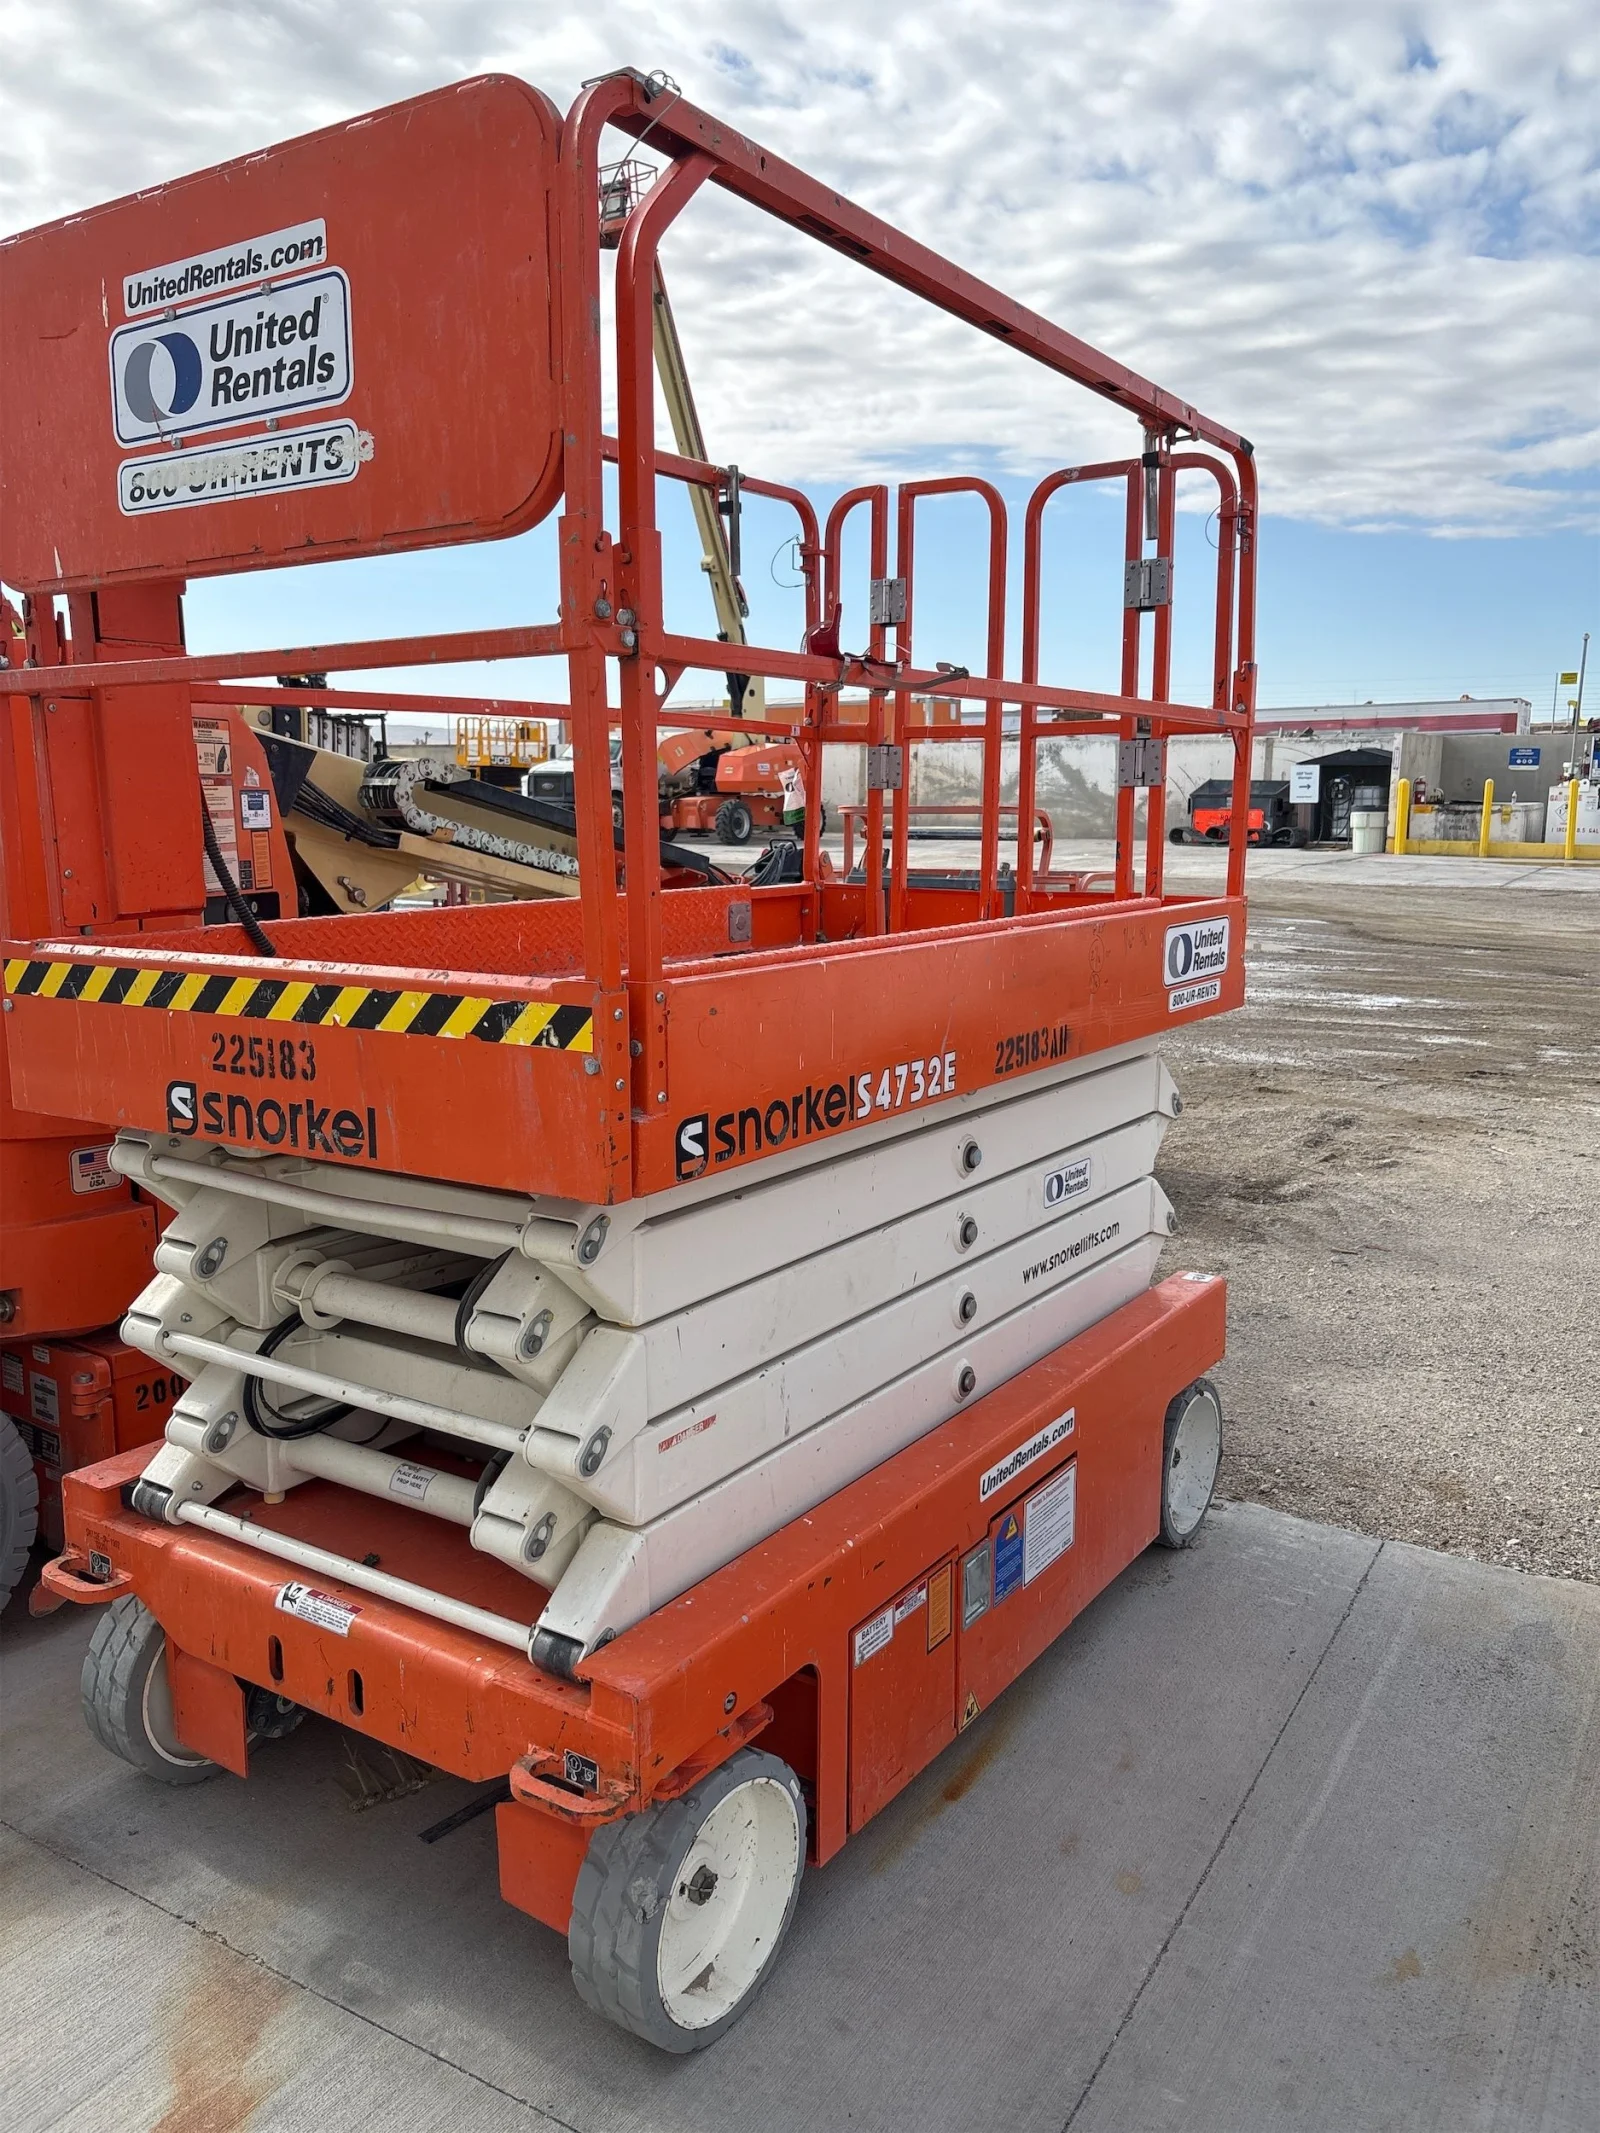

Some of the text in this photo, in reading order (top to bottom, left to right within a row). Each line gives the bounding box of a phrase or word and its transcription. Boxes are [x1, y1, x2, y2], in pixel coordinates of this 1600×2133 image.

[127, 235, 323, 309] UnitedRentals.com
[209, 296, 322, 362] United
[211, 344, 335, 407] Rentals
[492, 755, 511, 766] JCB
[1194, 925, 1225, 950] United
[1192, 947, 1226, 972] Rentals
[211, 1032, 316, 1081] 225183
[856, 1050, 957, 1120] S4732E
[90, 1179, 105, 1187] USA
[1064, 1163, 1088, 1183] United
[1064, 1177, 1089, 1196] Rentals
[1023, 1221, 1120, 1284] www.snorkellifts.com
[981, 1417, 1074, 1496] UnitedRentals.com
[324, 1594, 354, 1611] DANGER
[861, 1615, 887, 1641] BATTERY
